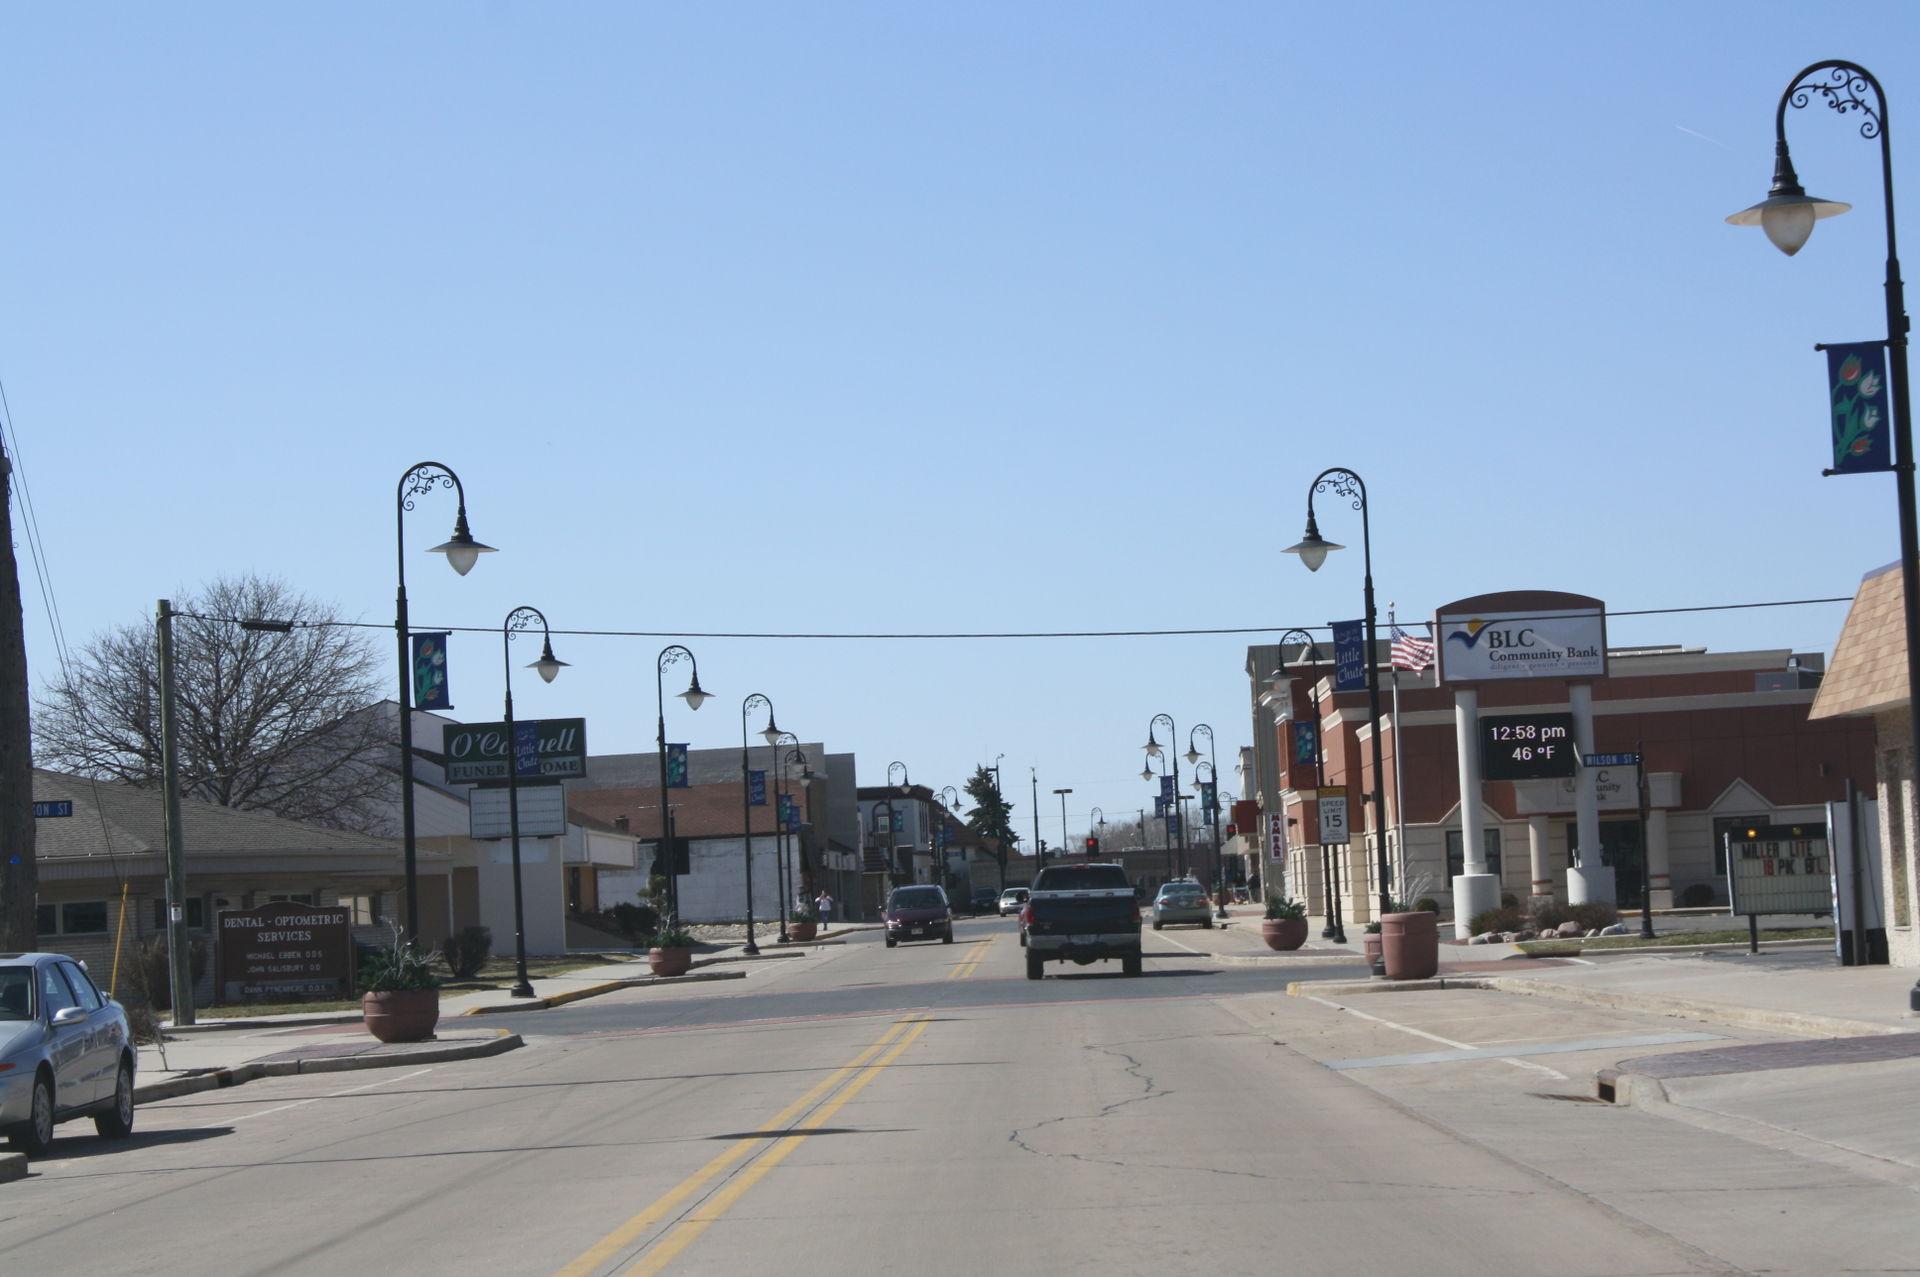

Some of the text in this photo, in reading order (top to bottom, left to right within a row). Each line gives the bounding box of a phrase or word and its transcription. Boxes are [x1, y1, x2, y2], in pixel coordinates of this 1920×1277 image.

[1487, 628, 1535, 649] BLC
[1336, 647, 1360, 666] Little
[1488, 646, 1599, 662] Community Bank
[1337, 667, 1363, 683] Chute
[1490, 725, 1566, 742] 12:58 pm
[451, 728, 576, 758] O'Coell
[1512, 746, 1533, 761] 46
[1586, 753, 1633, 766] WILSON ST
[453, 759, 579, 778] FUNER OME
[57, 802, 69, 815] ST
[1321, 799, 1345, 807] SPEED
[1324, 814, 1343, 828] 15
[1742, 840, 1814, 859] MILLER LITE
[1778, 859, 1795, 875] PK
[223, 916, 265, 928] DENTAL
[274, 914, 345, 927] OPTOMETRIC
[257, 930, 312, 943] SERVICES
